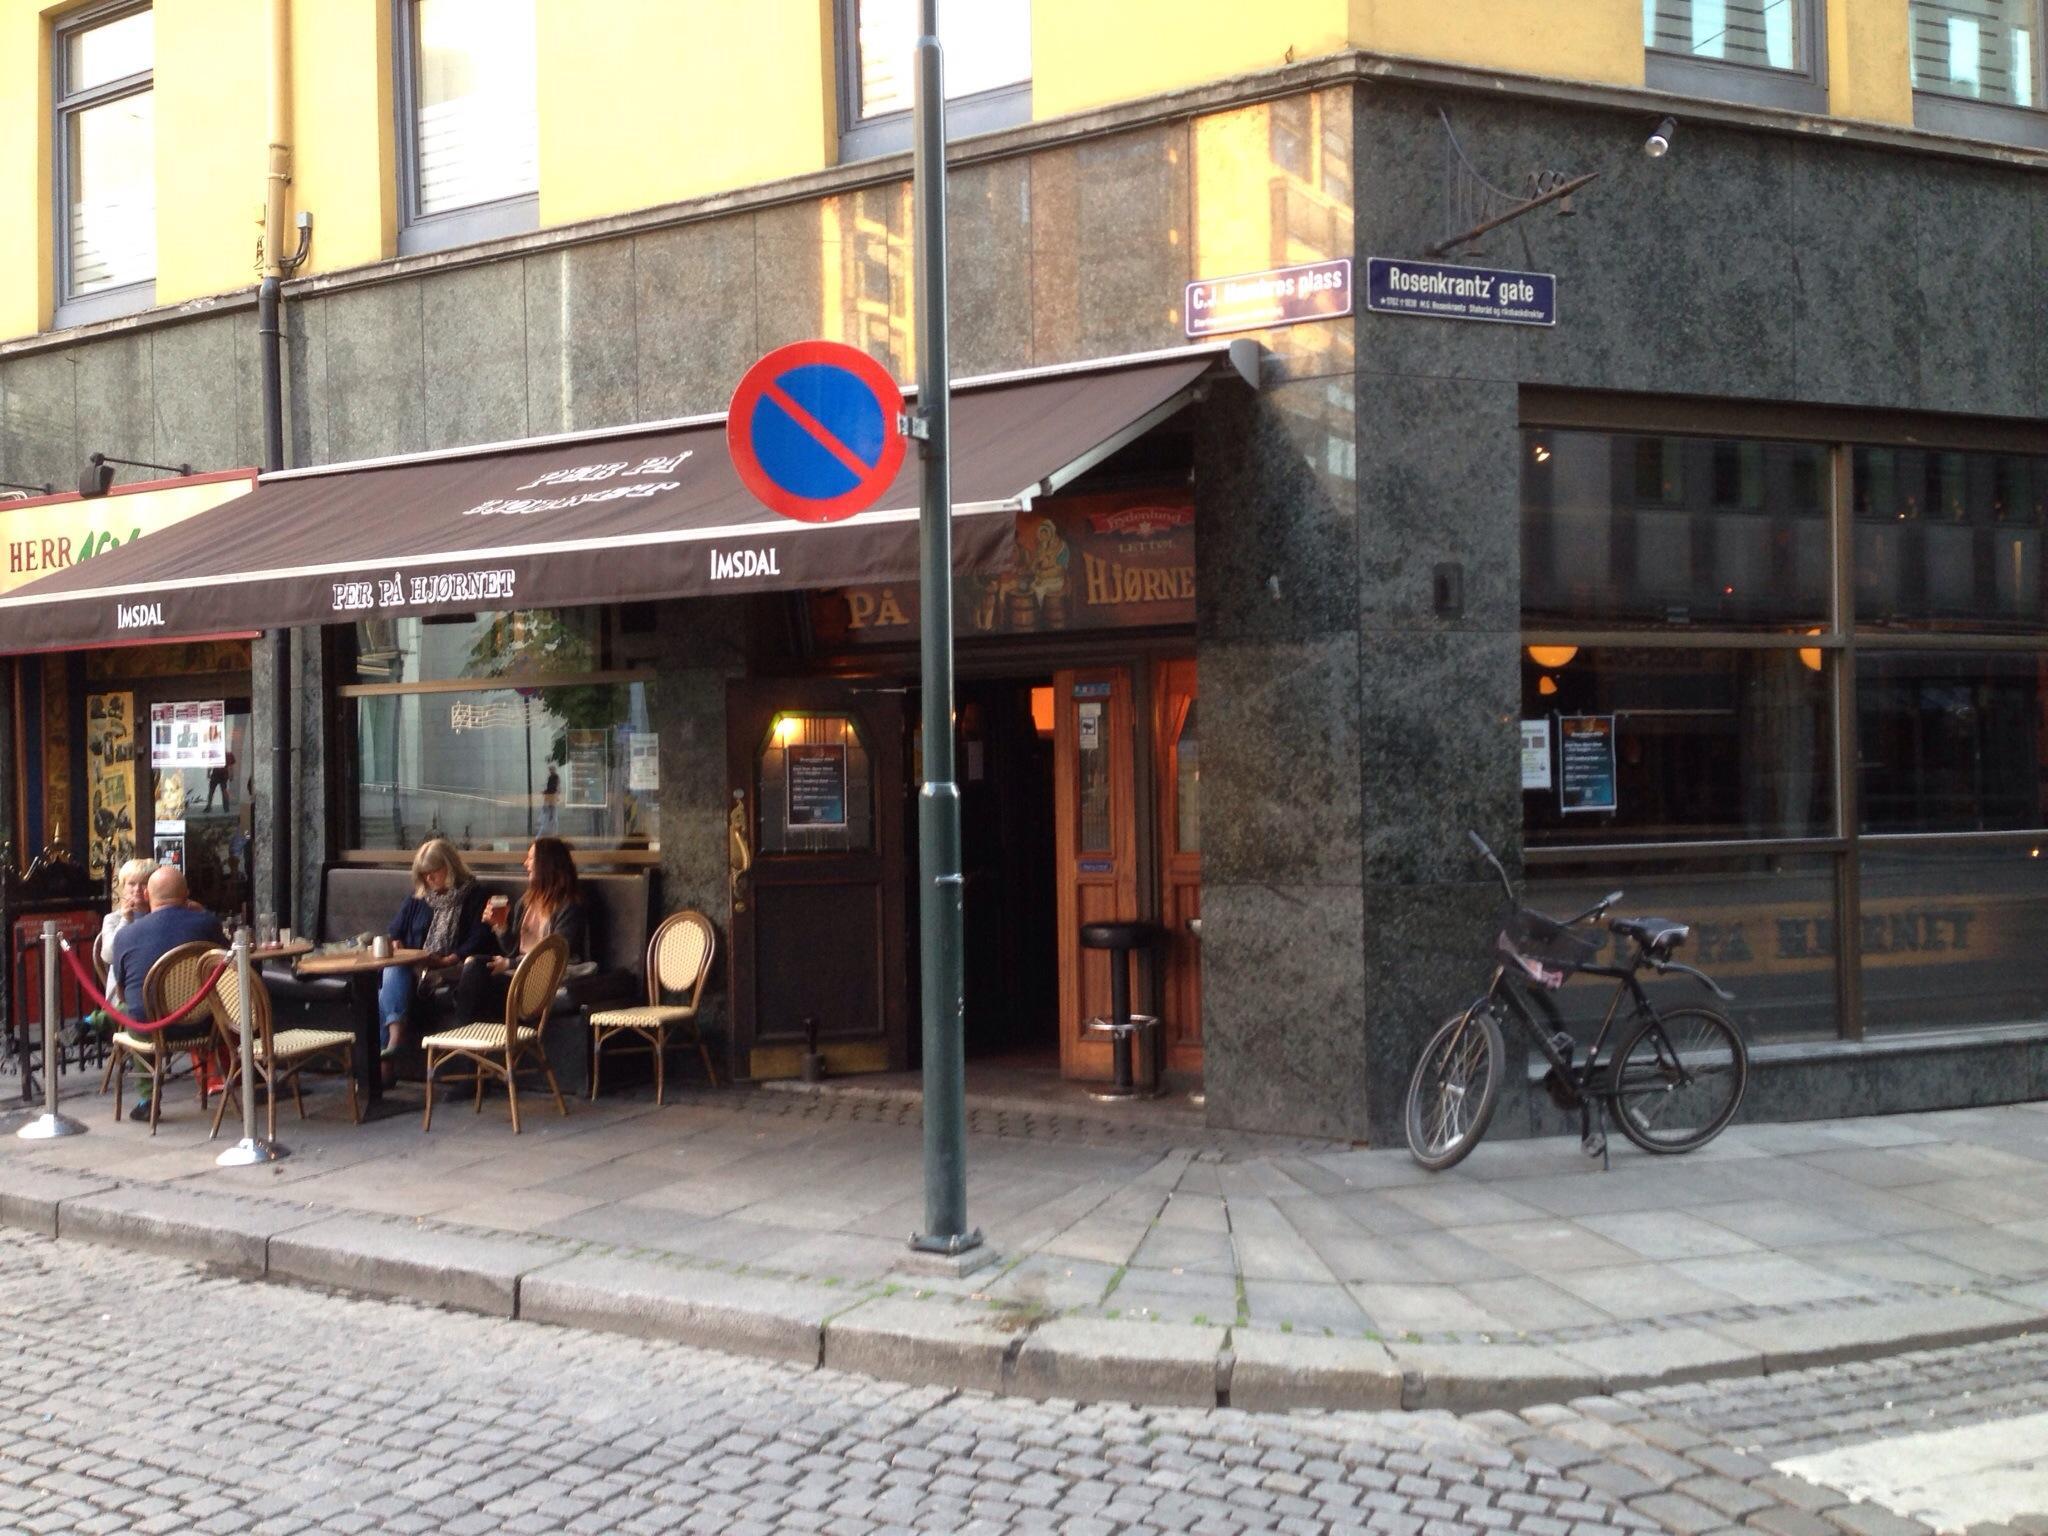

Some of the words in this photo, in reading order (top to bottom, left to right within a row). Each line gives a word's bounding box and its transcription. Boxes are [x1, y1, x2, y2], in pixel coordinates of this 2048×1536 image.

[1298, 270, 1342, 298] plass
[1389, 266, 1495, 299] Rosenkrantz'
[1500, 279, 1534, 305] gate
[10, 536, 73, 573] HERR
[710, 547, 781, 580] IMSDAL
[332, 582, 374, 610] PER
[378, 571, 405, 607] PÅ
[410, 569, 516, 605] HJØRNET
[845, 588, 910, 628] PÅ
[117, 602, 166, 630] IMSDAL
